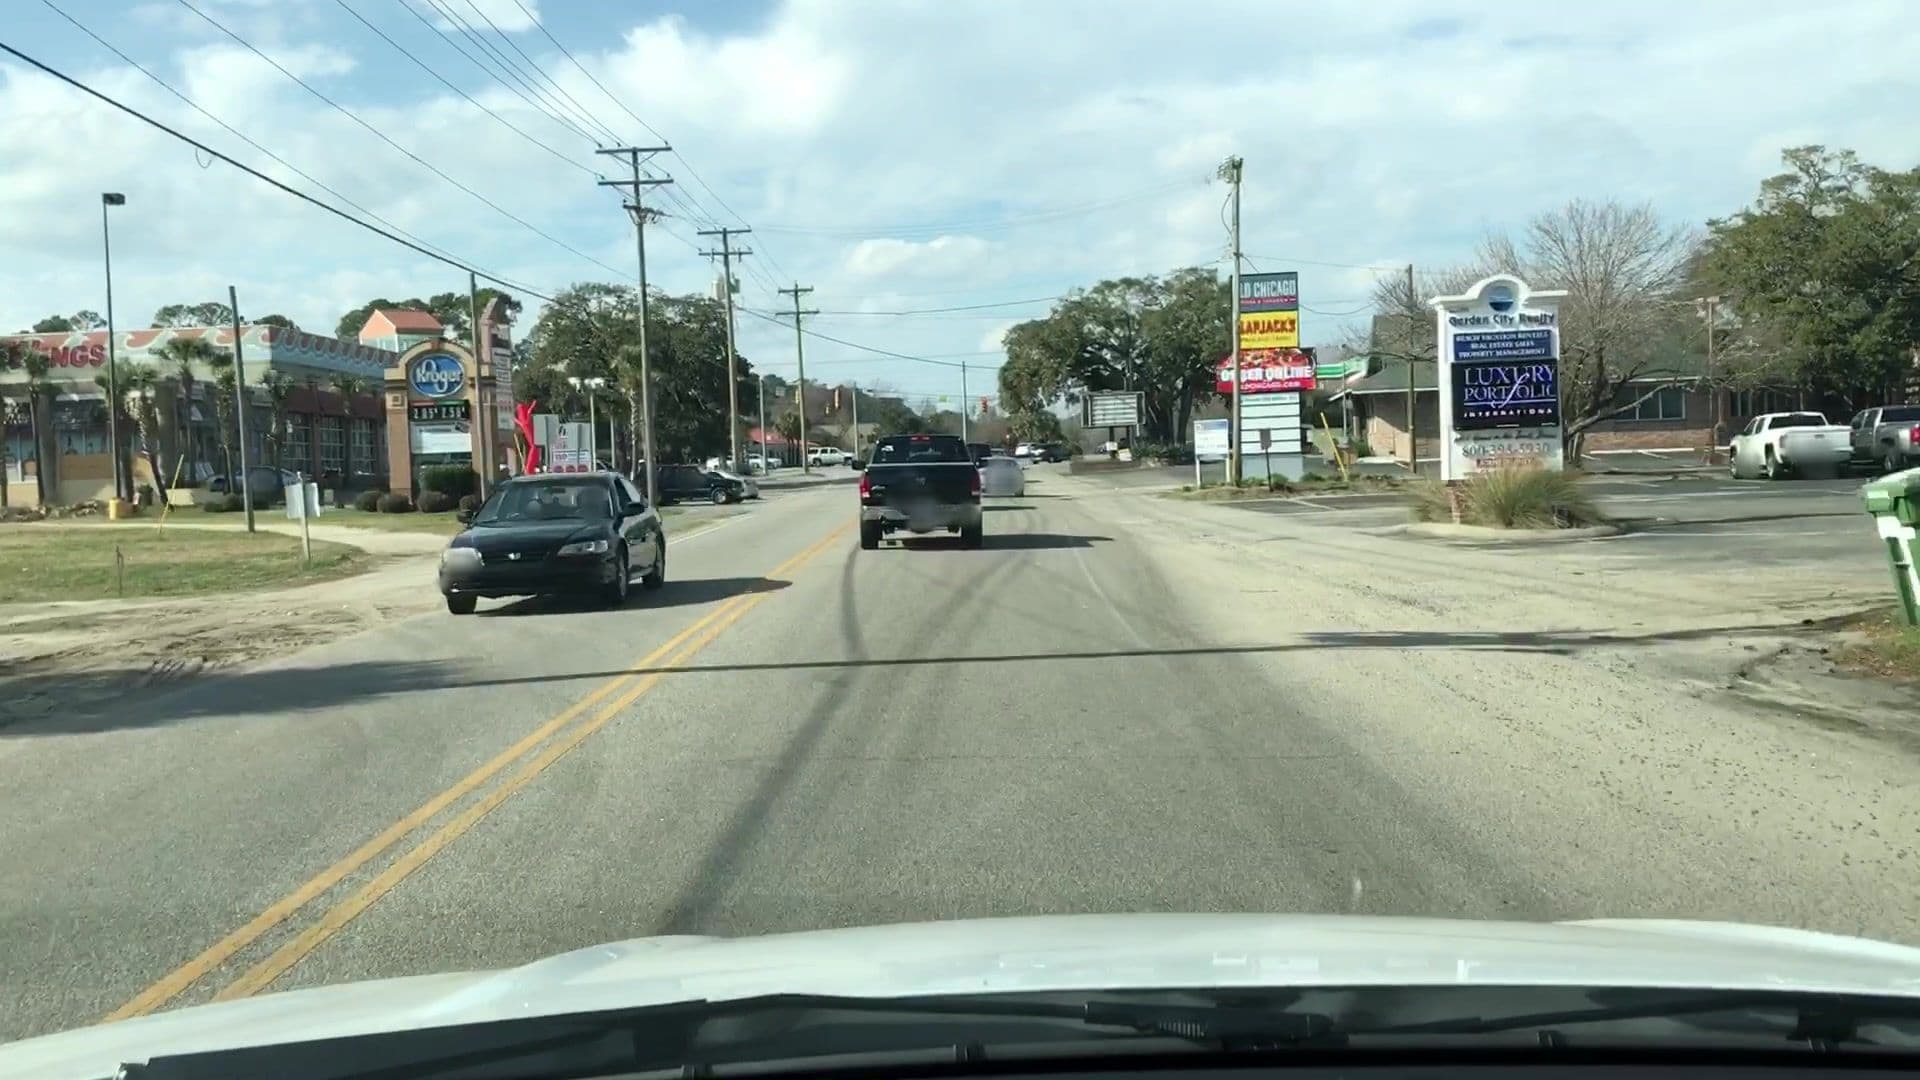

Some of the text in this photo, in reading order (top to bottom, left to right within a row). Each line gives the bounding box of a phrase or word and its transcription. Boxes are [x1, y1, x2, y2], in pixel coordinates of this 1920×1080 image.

[1253, 280, 1296, 298] CHICAGO
[1449, 313, 1555, 327] Garden City Realty
[416, 359, 461, 393] Kroger
[1265, 366, 1313, 381] ONLINE
[1464, 365, 1555, 386] LUXURY
